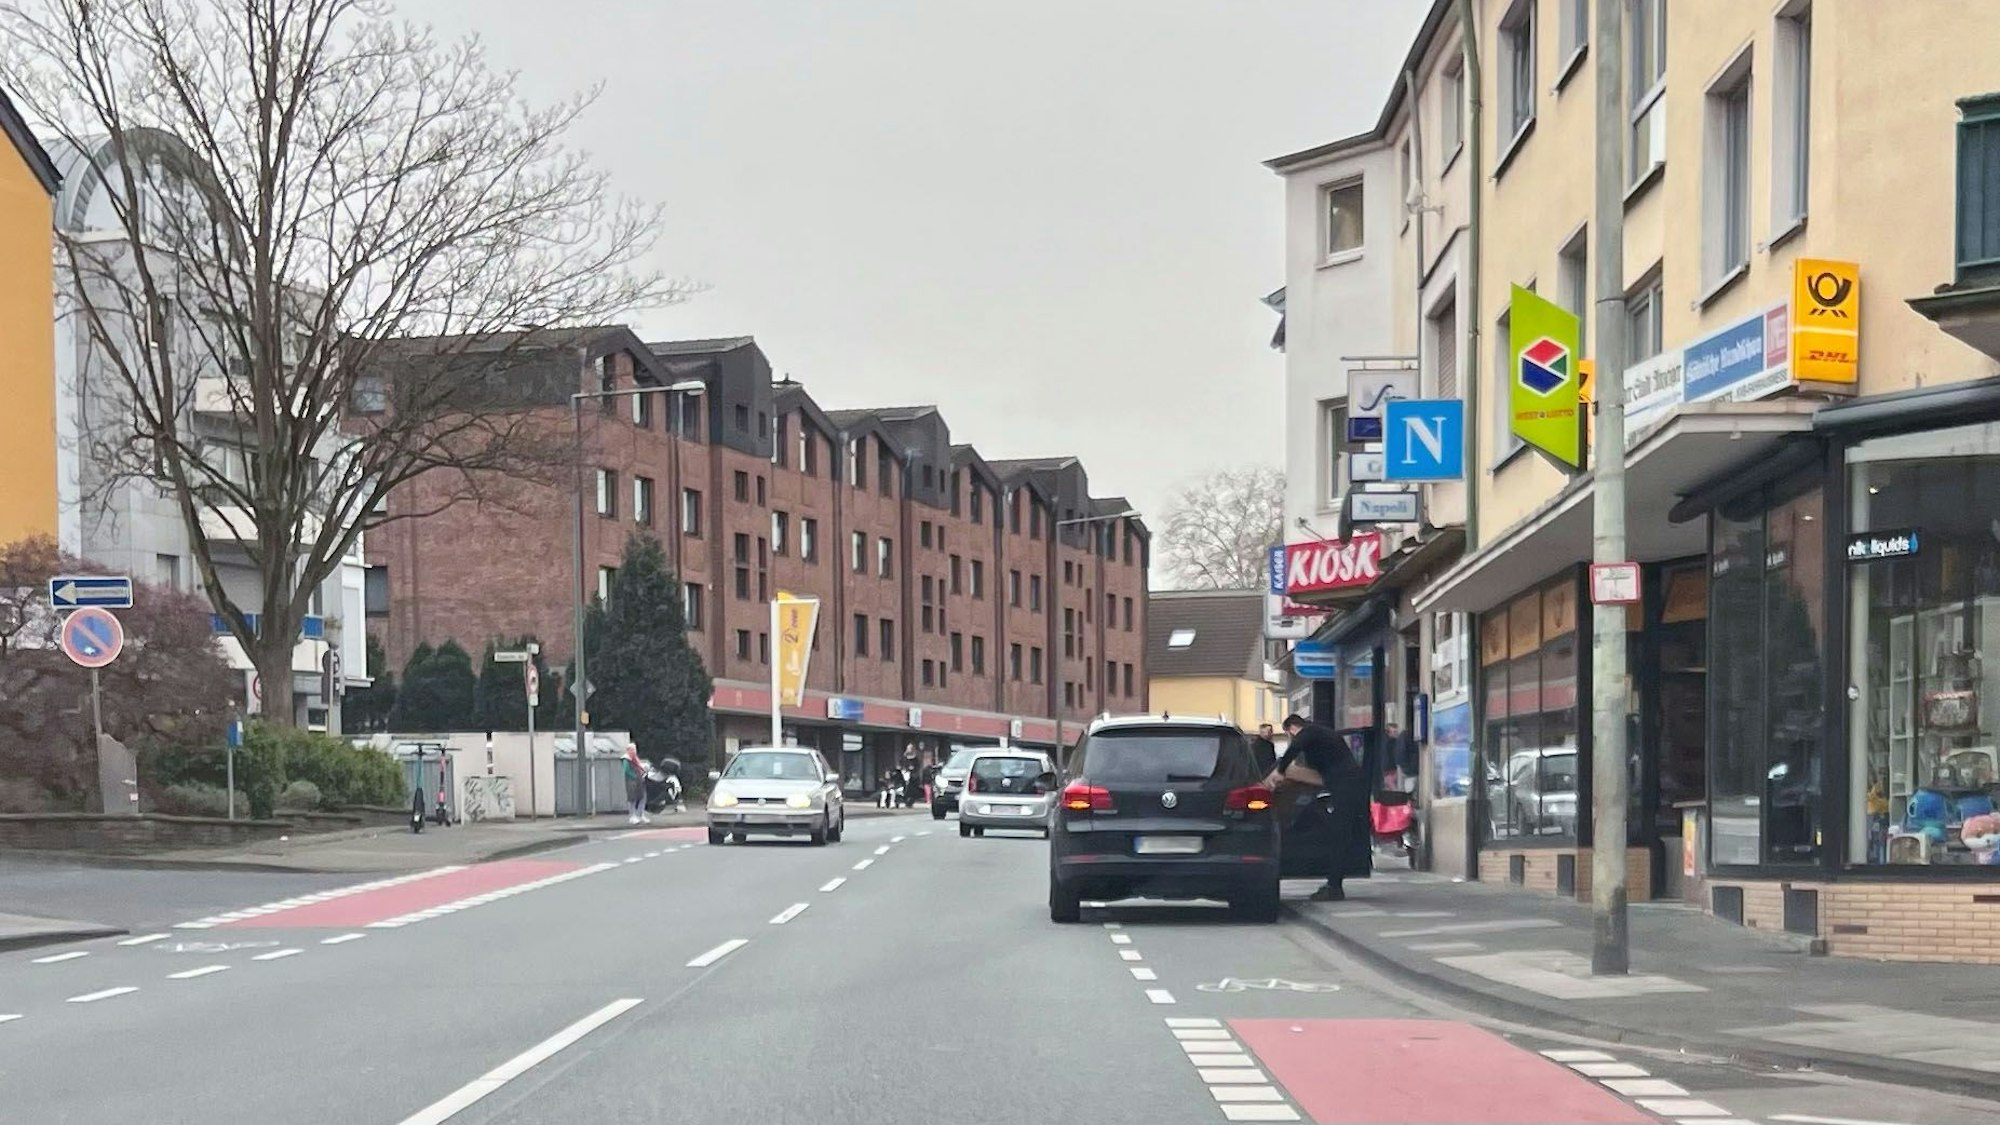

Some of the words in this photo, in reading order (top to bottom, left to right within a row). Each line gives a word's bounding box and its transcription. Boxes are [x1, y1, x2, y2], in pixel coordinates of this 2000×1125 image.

[1401, 416, 1447, 464] N
[1361, 501, 1408, 517] Napoli
[1287, 541, 1379, 587] KIOSK
